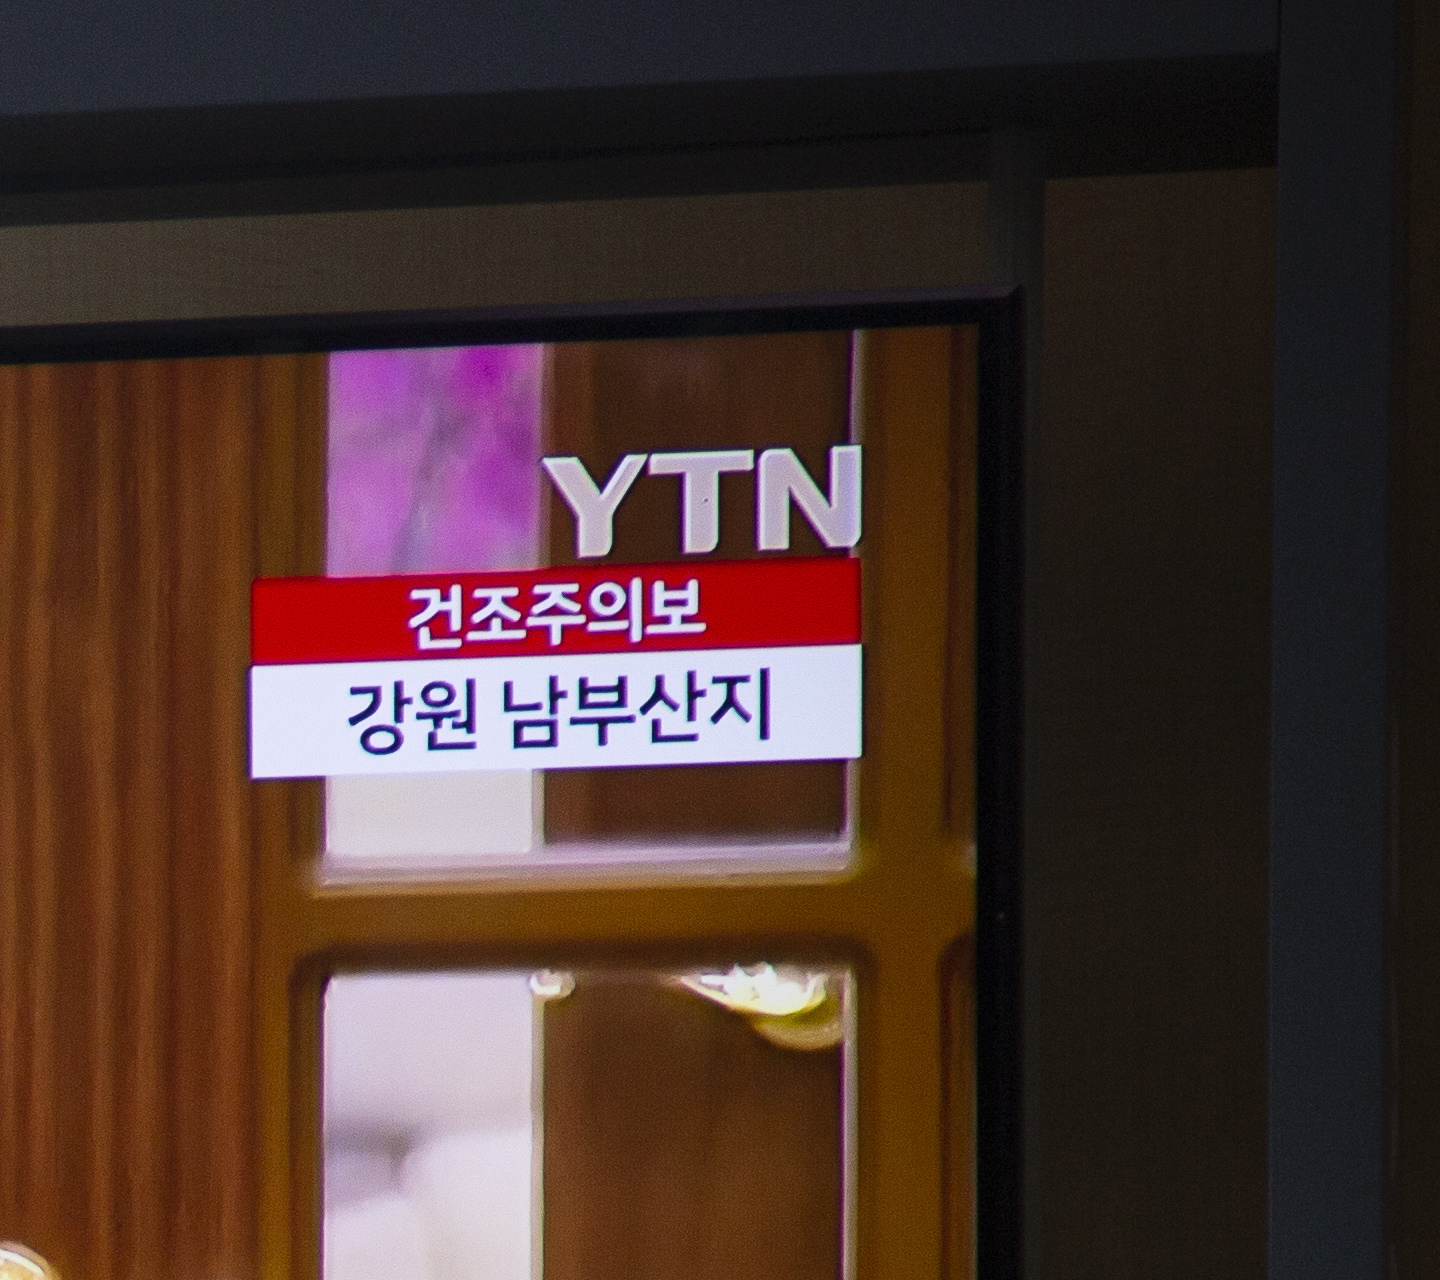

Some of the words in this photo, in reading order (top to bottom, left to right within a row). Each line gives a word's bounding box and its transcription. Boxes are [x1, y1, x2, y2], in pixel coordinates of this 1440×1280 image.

[541, 444, 863, 559] YTN
[407, 576, 708, 651] 건조주의보
[347, 677, 478, 757] 강원
[502, 666, 771, 750] 남부산지
